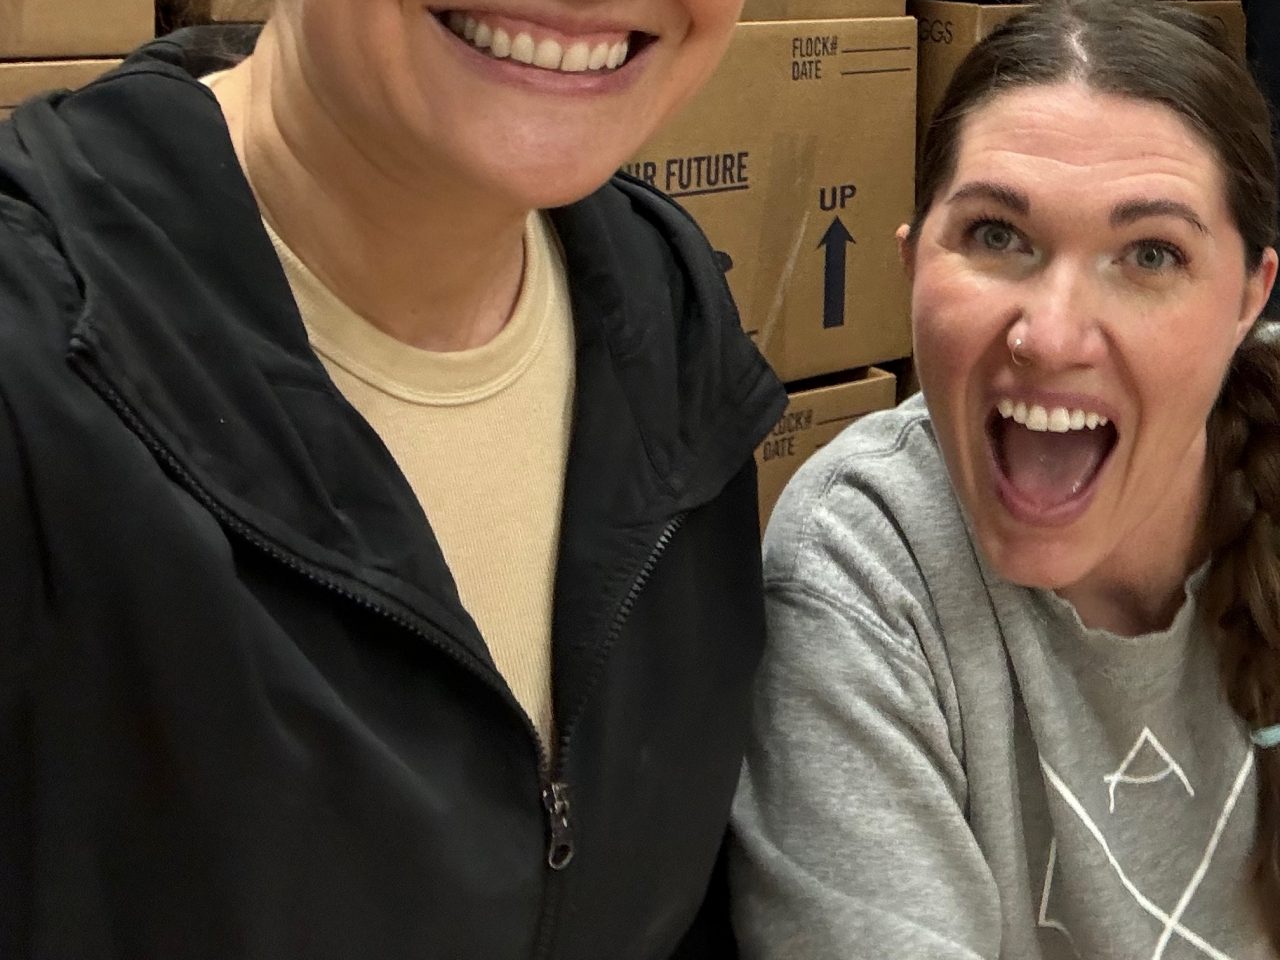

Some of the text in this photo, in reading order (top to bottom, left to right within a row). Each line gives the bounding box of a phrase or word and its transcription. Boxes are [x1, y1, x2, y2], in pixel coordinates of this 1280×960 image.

[791, 36, 838, 60] FLOCK#
[791, 60, 822, 81] DATE
[665, 151, 750, 191] FUTURE
[819, 185, 857, 212] UP
[763, 437, 796, 462] DATE
